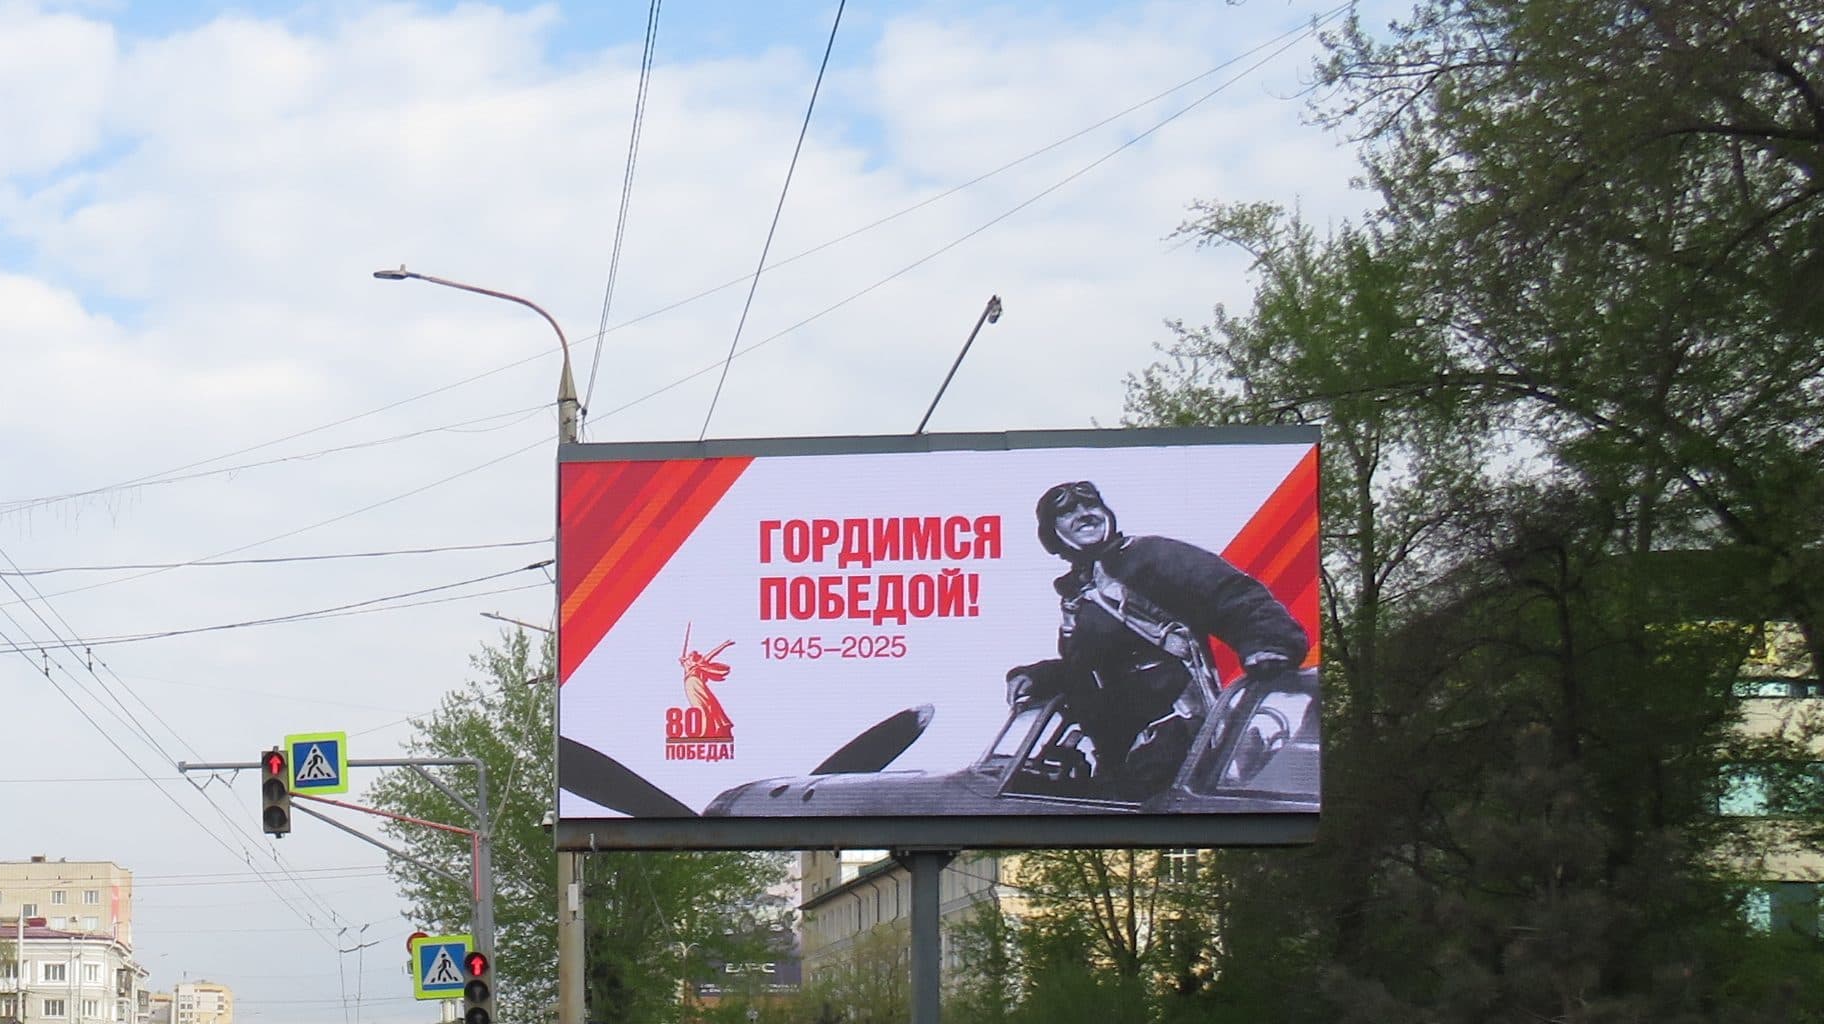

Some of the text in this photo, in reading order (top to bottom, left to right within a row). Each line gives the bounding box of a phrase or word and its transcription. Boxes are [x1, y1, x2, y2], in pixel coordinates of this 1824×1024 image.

[759, 515, 1002, 567] ГОРДИМСЯ
[759, 569, 979, 625] ПОБЕДОЙ!
[666, 707, 702, 738] 80
[665, 744, 735, 762] ПОБЕДА!
